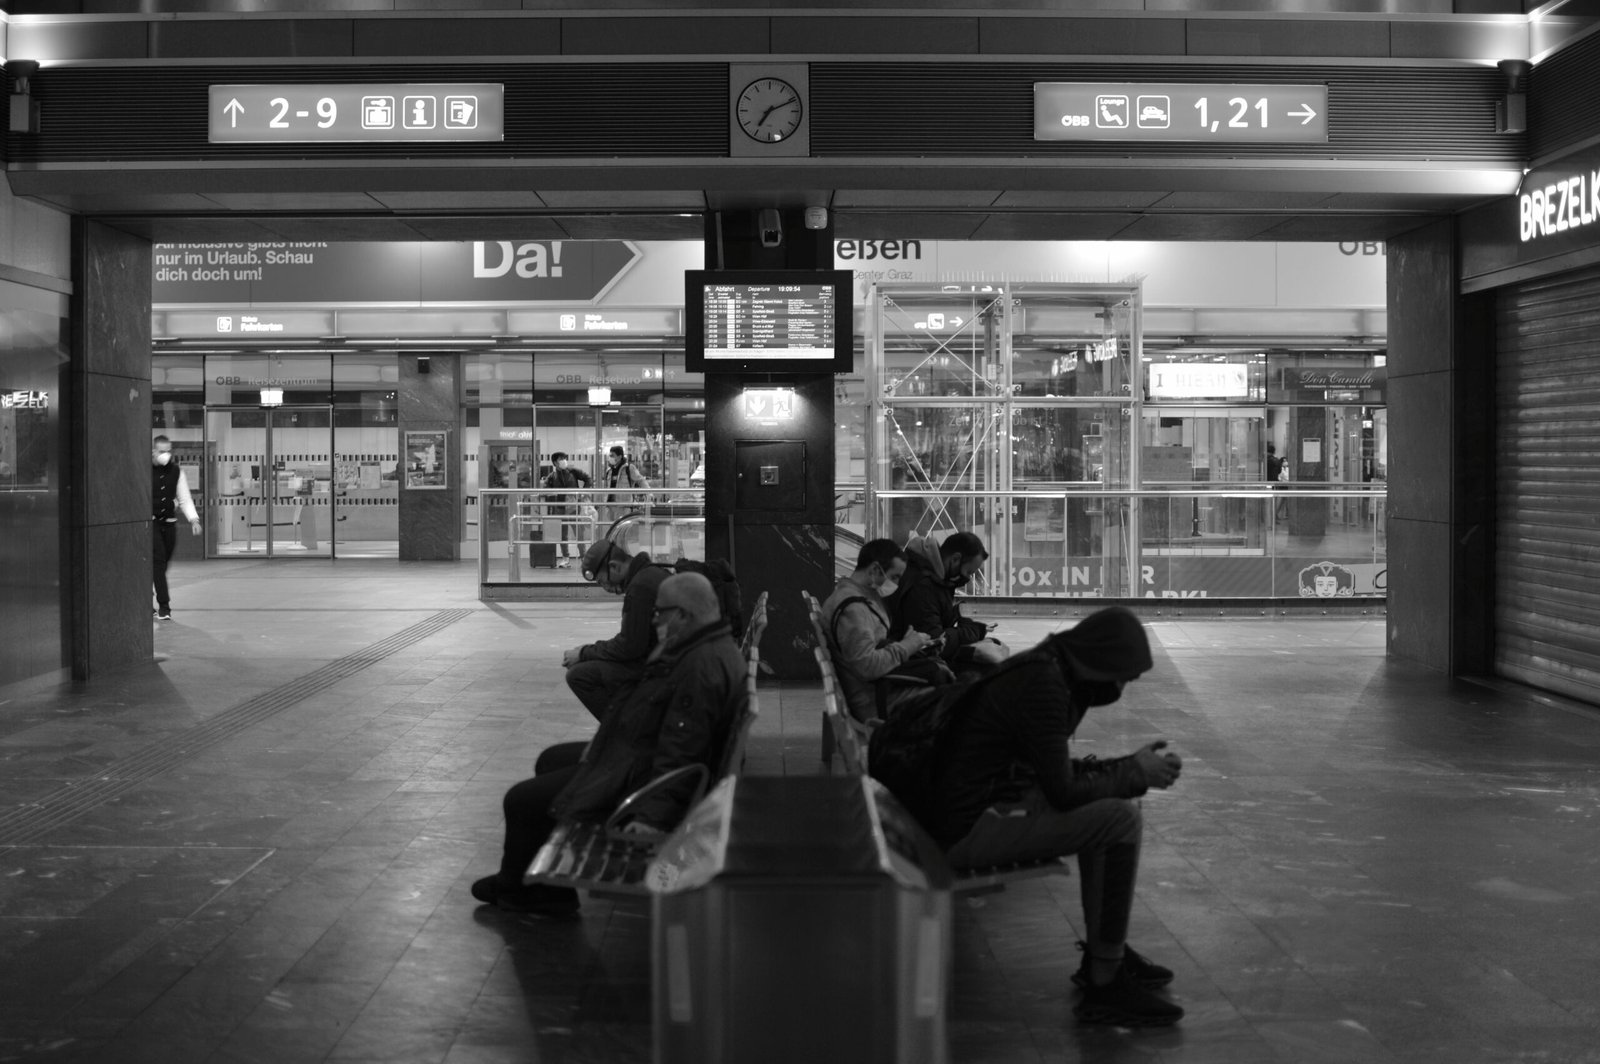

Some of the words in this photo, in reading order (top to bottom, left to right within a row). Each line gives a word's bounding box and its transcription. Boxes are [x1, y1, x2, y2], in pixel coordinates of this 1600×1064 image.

[1100, 98, 1125, 106] Lounge
[269, 97, 337, 129] 2-9
[155, 254, 182, 265] nur
[185, 251, 203, 265] im
[207, 250, 262, 265] Urlaub.
[265, 250, 314, 265] Schau
[473, 241, 563, 279] Da!
[155, 267, 188, 281] dich
[191, 267, 230, 281] doch
[233, 267, 263, 281] um!
[887, 269, 913, 280] Graz
[216, 375, 241, 385] ÖBB
[248, 376, 317, 386] Reisezentrum
[1062, 566, 1090, 586] IN
